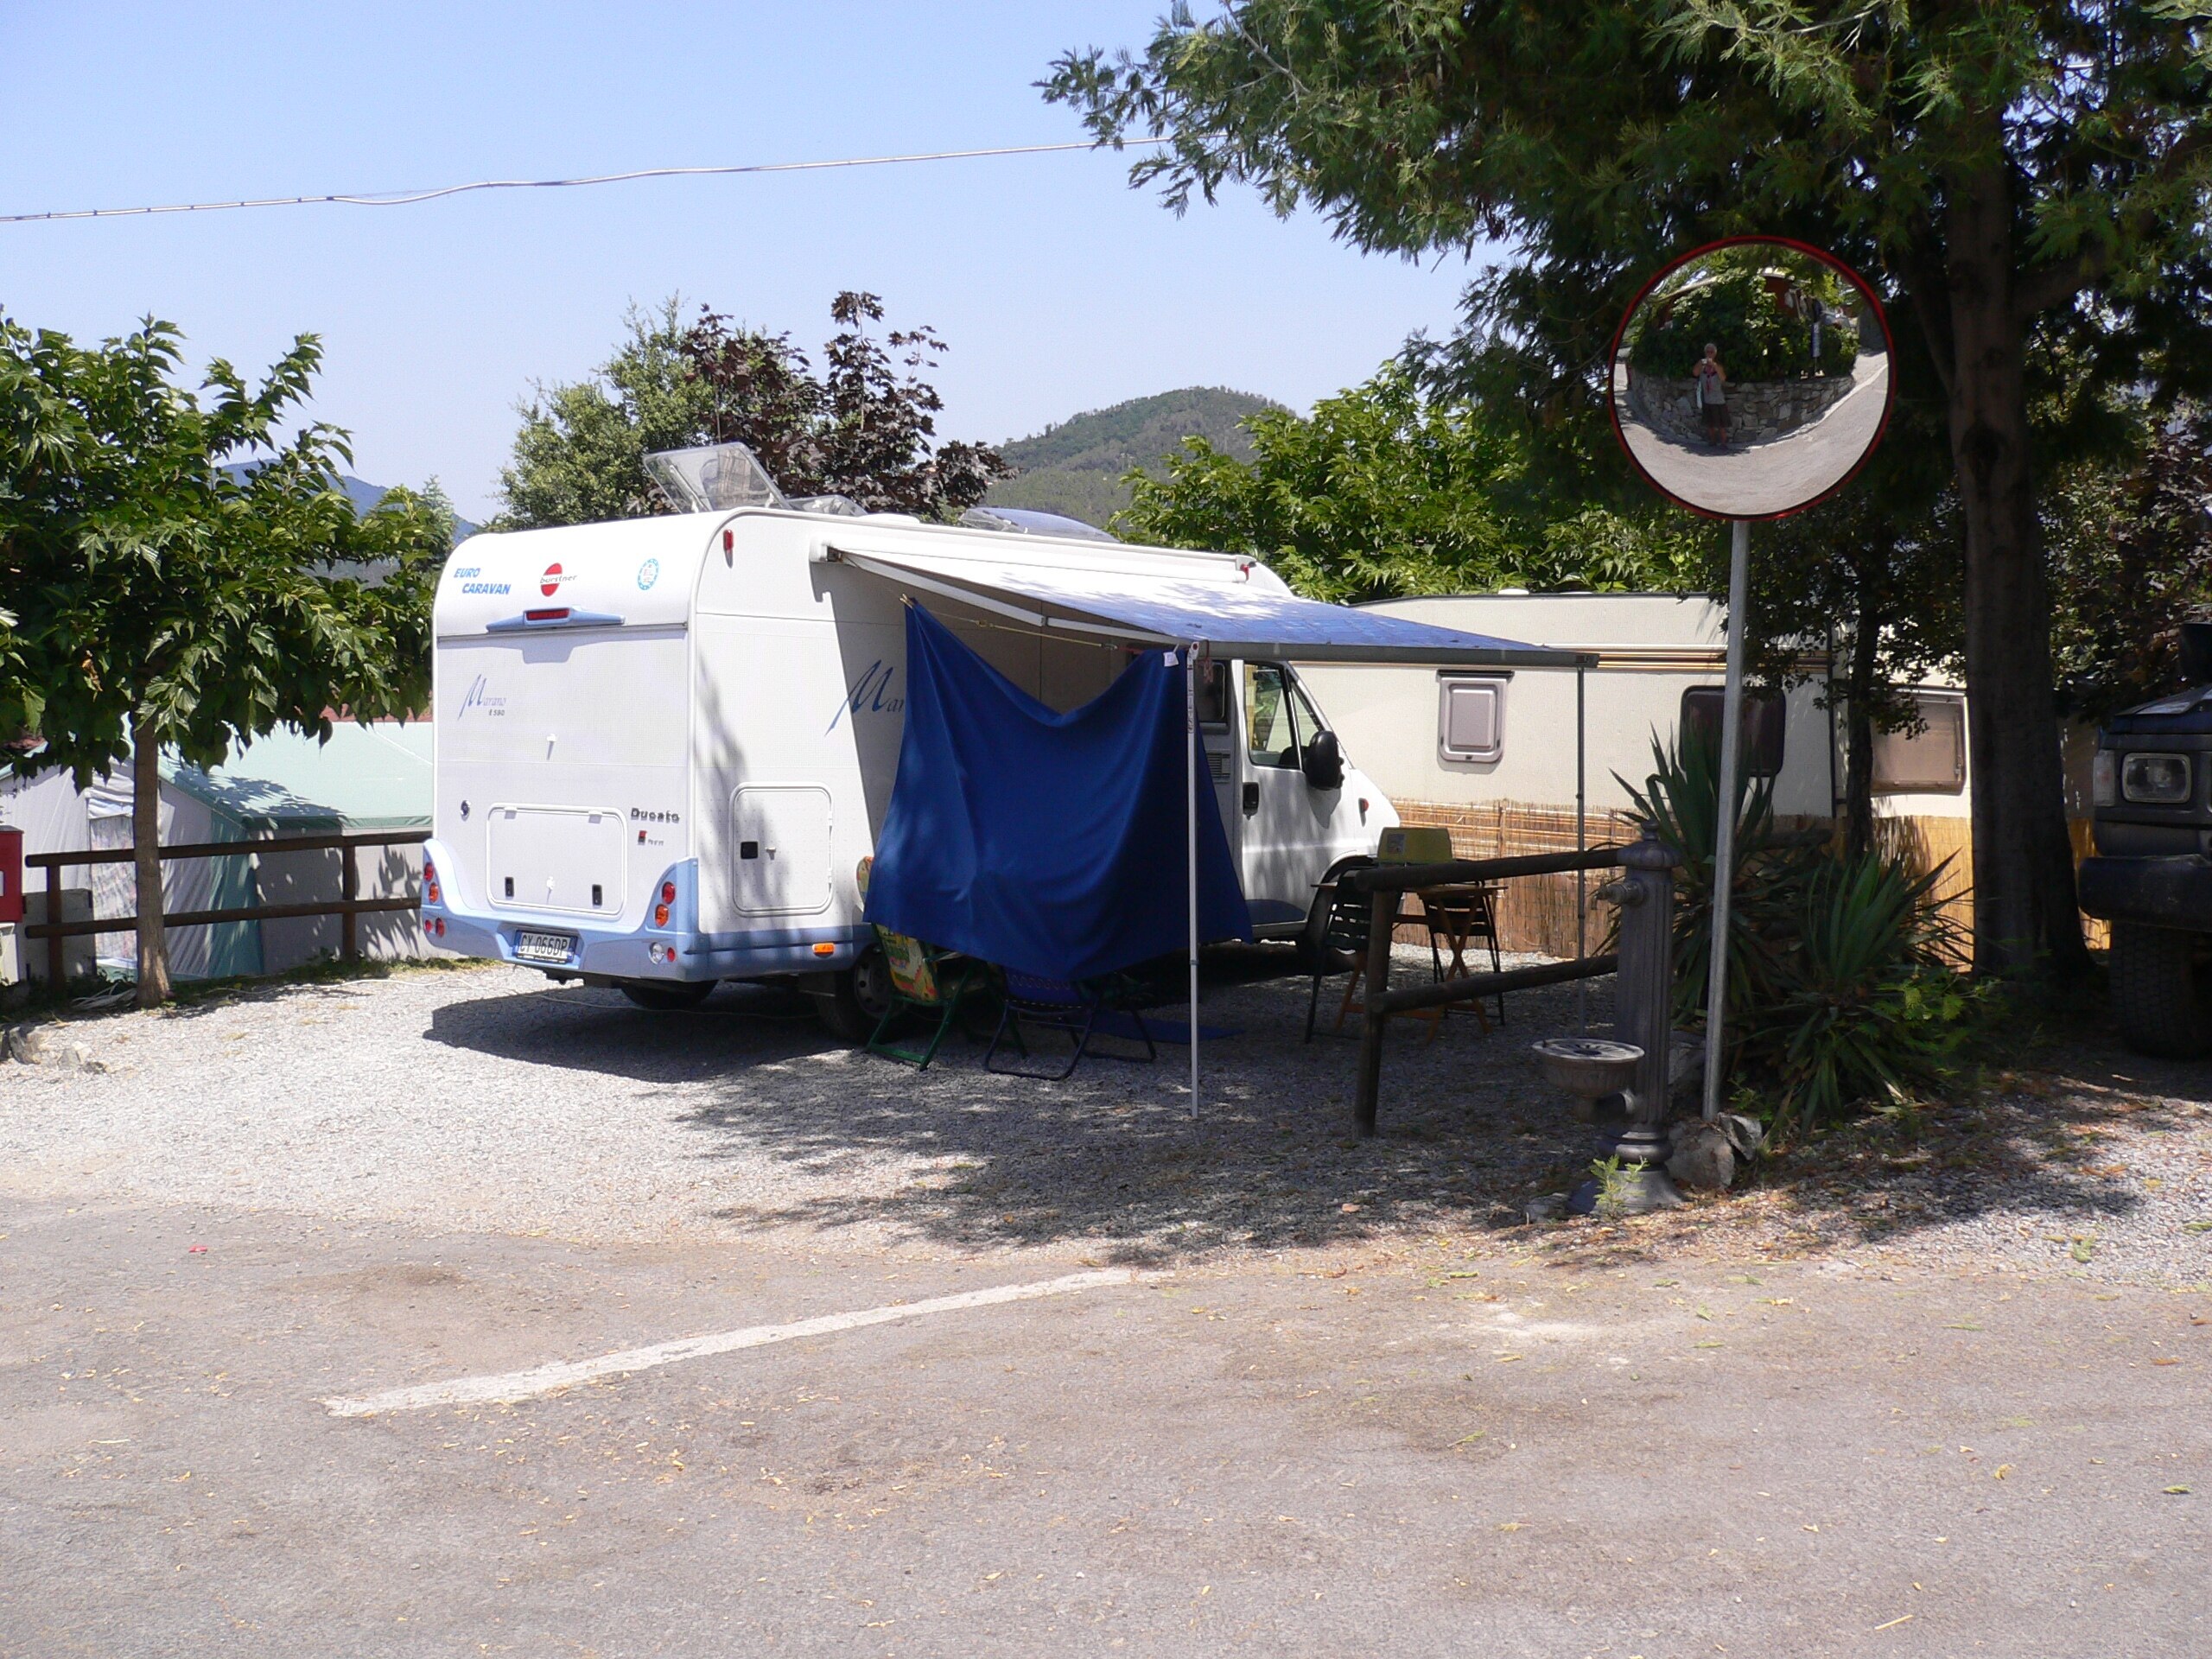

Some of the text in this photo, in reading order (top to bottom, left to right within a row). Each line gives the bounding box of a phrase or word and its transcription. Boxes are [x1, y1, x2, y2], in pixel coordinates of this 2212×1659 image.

[454, 567, 481, 579] EURO
[461, 582, 512, 595] CARAVAN
[630, 807, 680, 823] Ducato
[520, 934, 534, 952] CY
